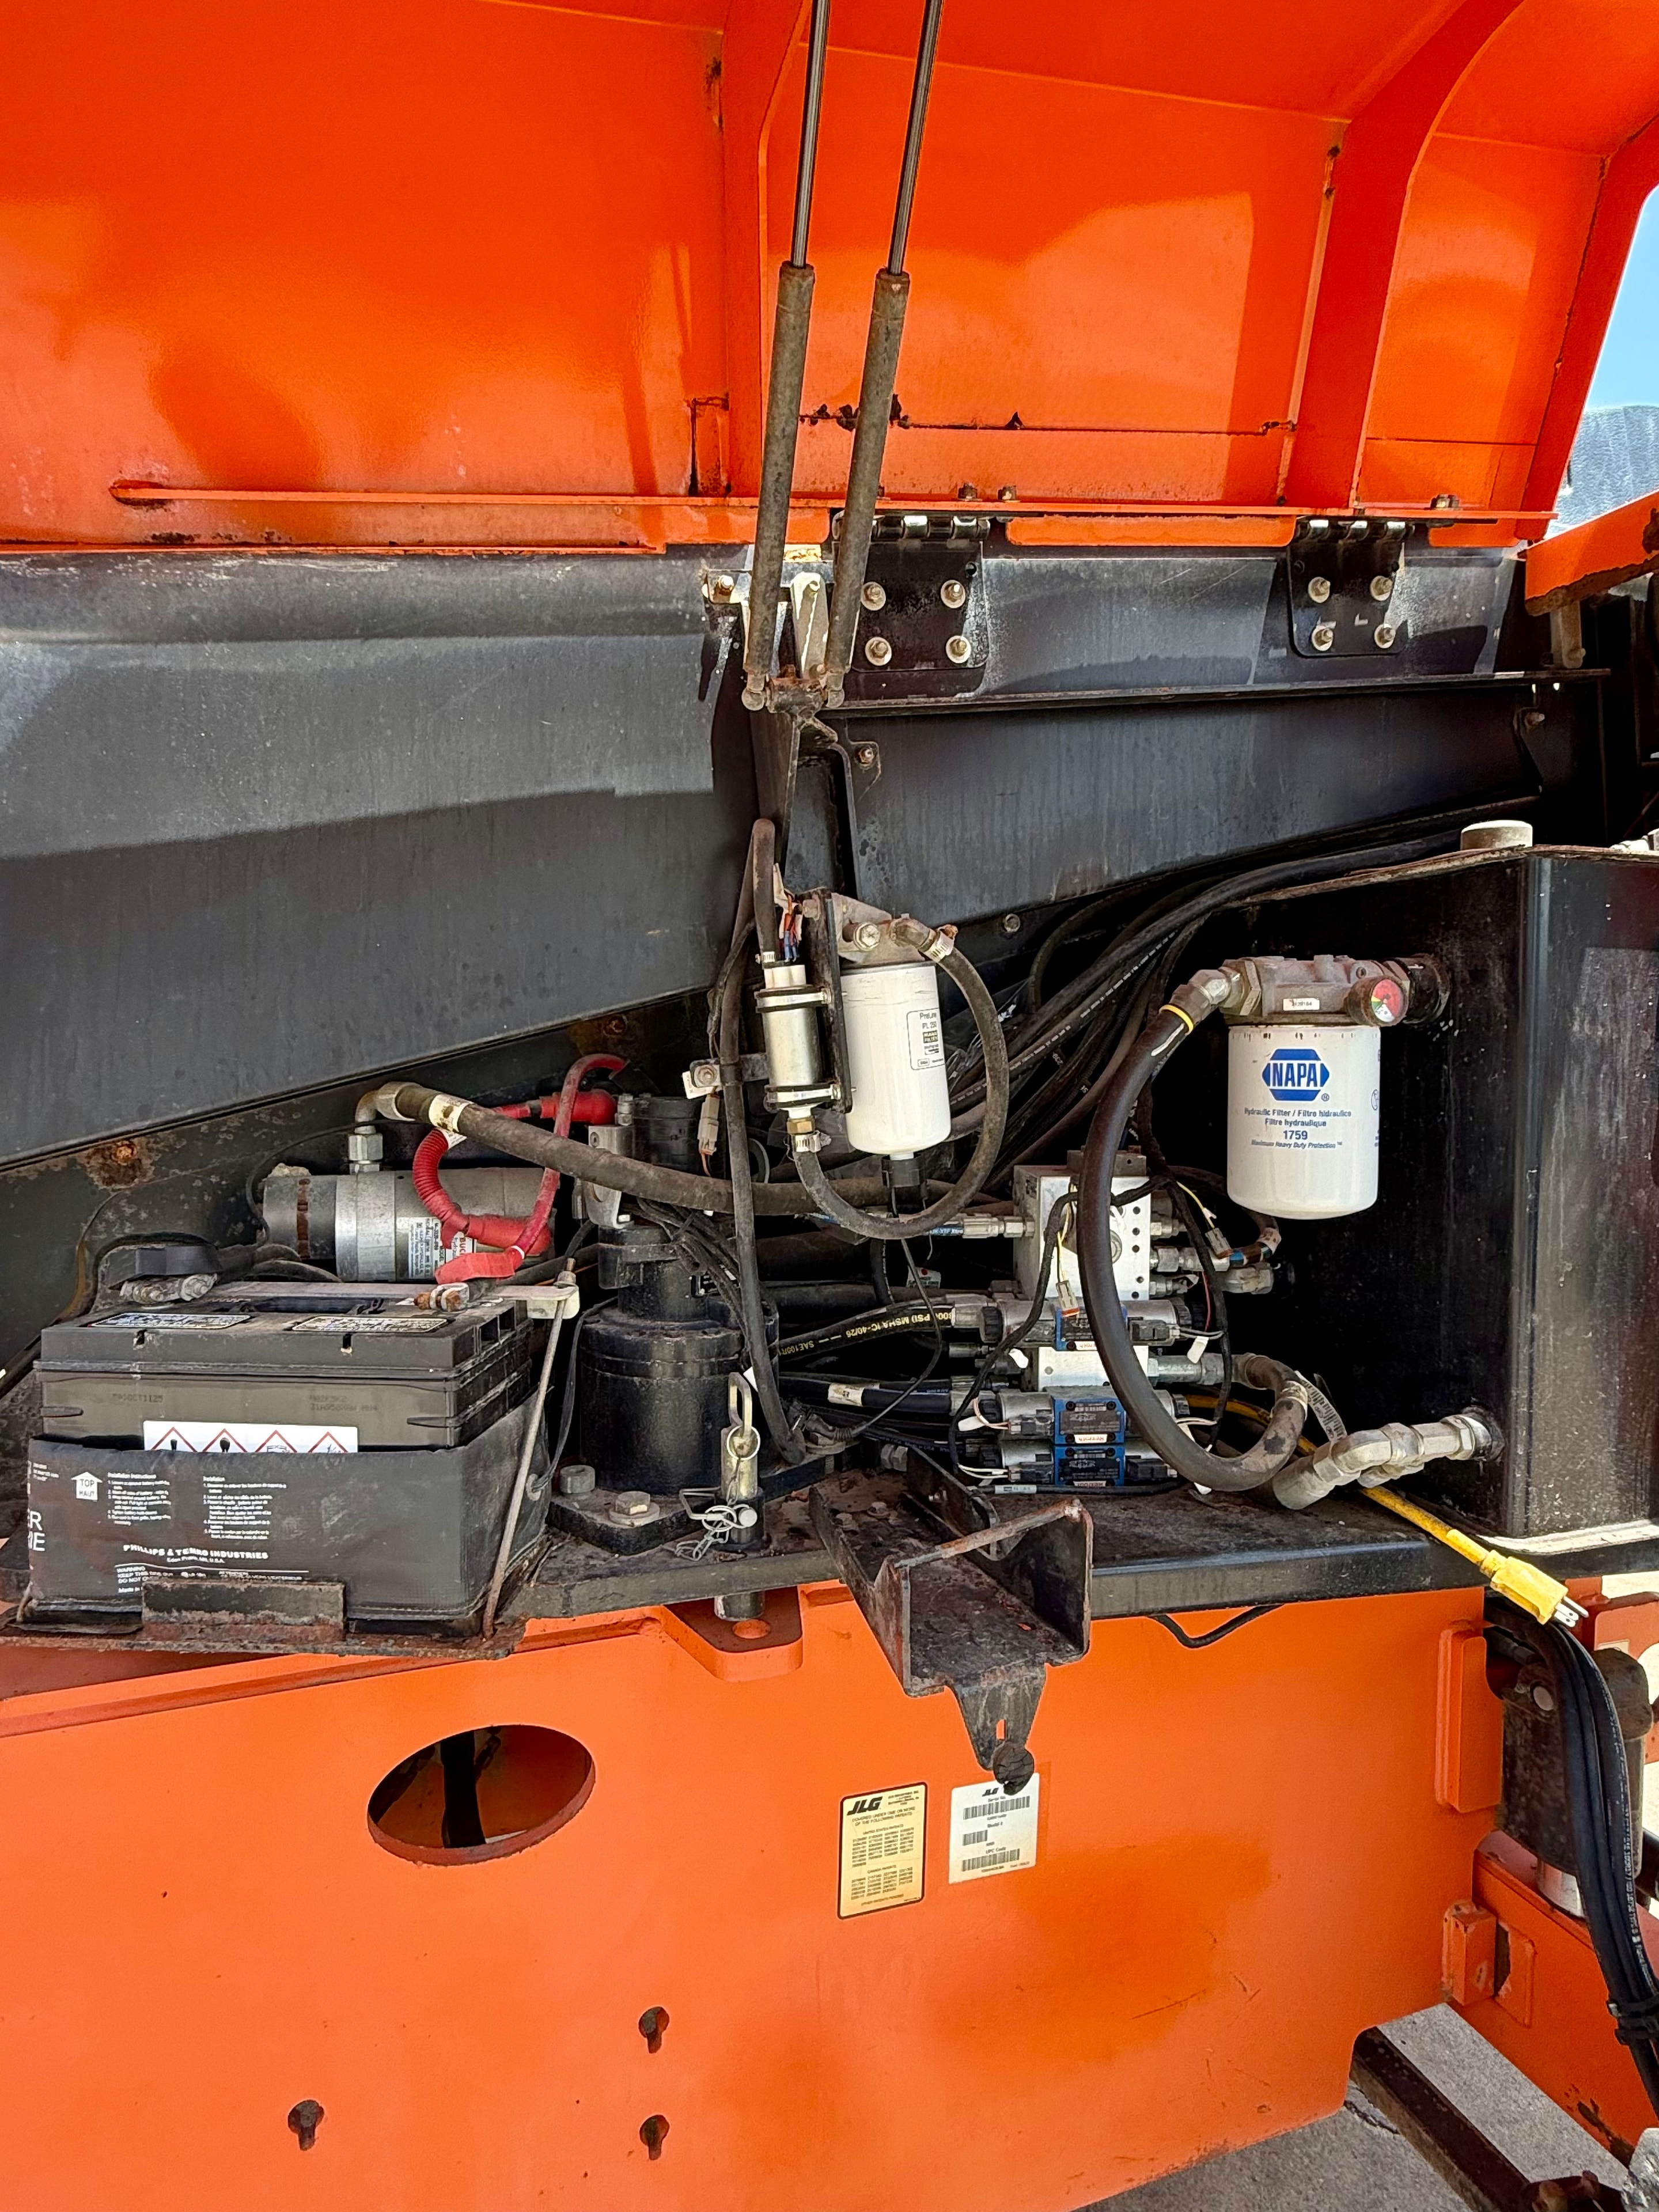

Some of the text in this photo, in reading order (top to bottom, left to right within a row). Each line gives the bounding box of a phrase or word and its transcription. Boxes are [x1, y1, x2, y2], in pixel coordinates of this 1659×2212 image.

[1272, 1063, 1318, 1088] NAPA
[1272, 1109, 1291, 1117] Filter
[1297, 1109, 1317, 1118] Filtro
[1265, 1118, 1327, 1128] Filtre hydraulique
[1283, 1130, 1308, 1141] 1759
[1293, 1142, 1307, 1150] Duty
[881, 1316, 910, 1329] MSHA
[80, 1478, 94, 1487] TOP
[79, 1490, 95, 1498] HAUT
[123, 1544, 166, 1556] PHILLIPS
[210, 1550, 269, 1559] INDUSTRIES
[847, 1796, 883, 1816] JLG
